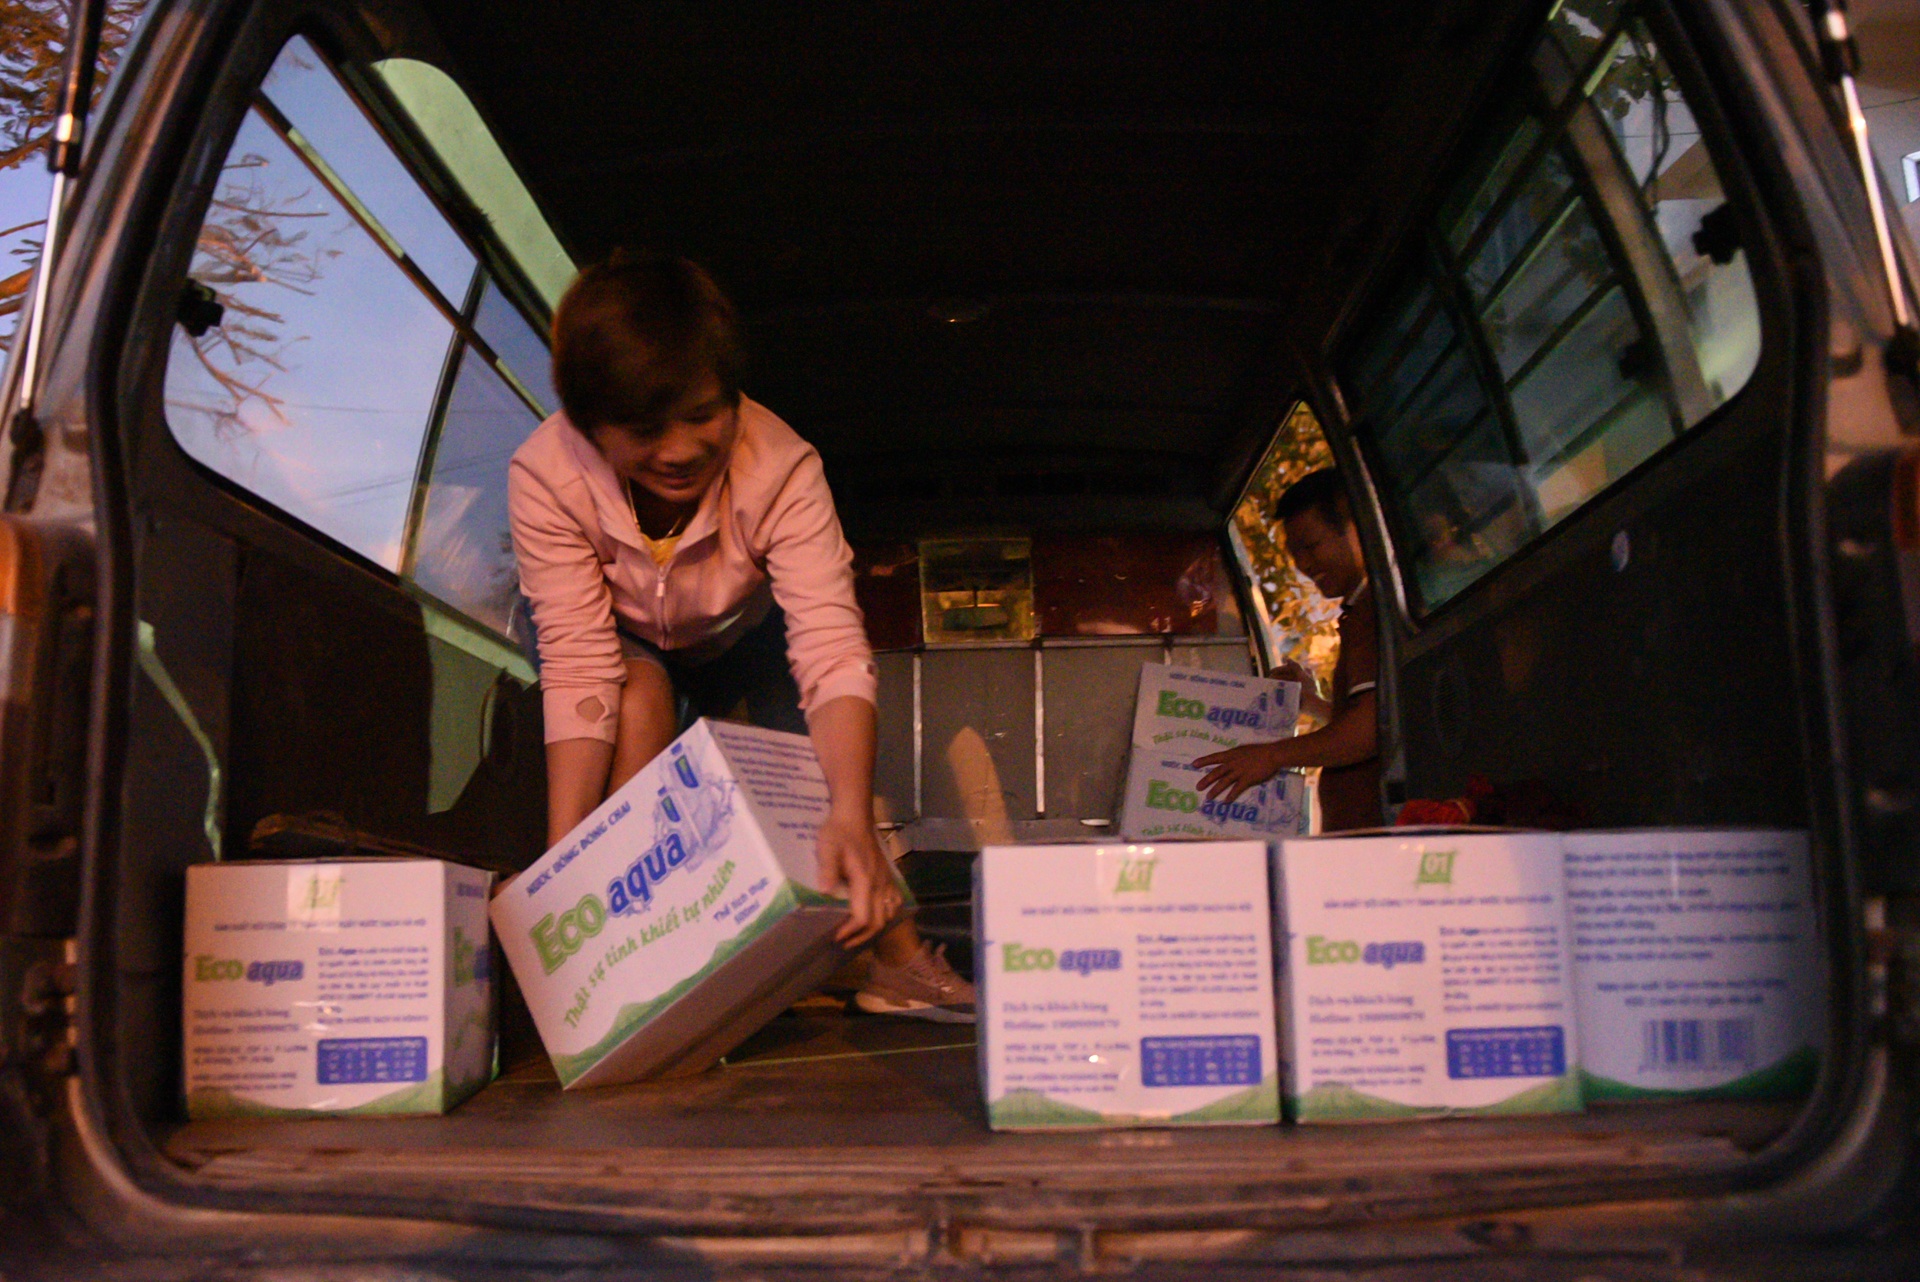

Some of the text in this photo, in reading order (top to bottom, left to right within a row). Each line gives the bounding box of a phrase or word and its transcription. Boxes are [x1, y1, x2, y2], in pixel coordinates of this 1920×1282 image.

[1156, 690, 1261, 730] Eco aqua
[1146, 779, 1259, 824] Eco aqua
[529, 893, 606, 976] Eco
[607, 832, 688, 917] aqua
[605, 937, 638, 967] tinh
[1002, 943, 1056, 972] Eco
[1060, 949, 1122, 977] aqua
[1306, 935, 1361, 965] Eco
[195, 955, 243, 982] Eco
[247, 960, 304, 986] aqua
